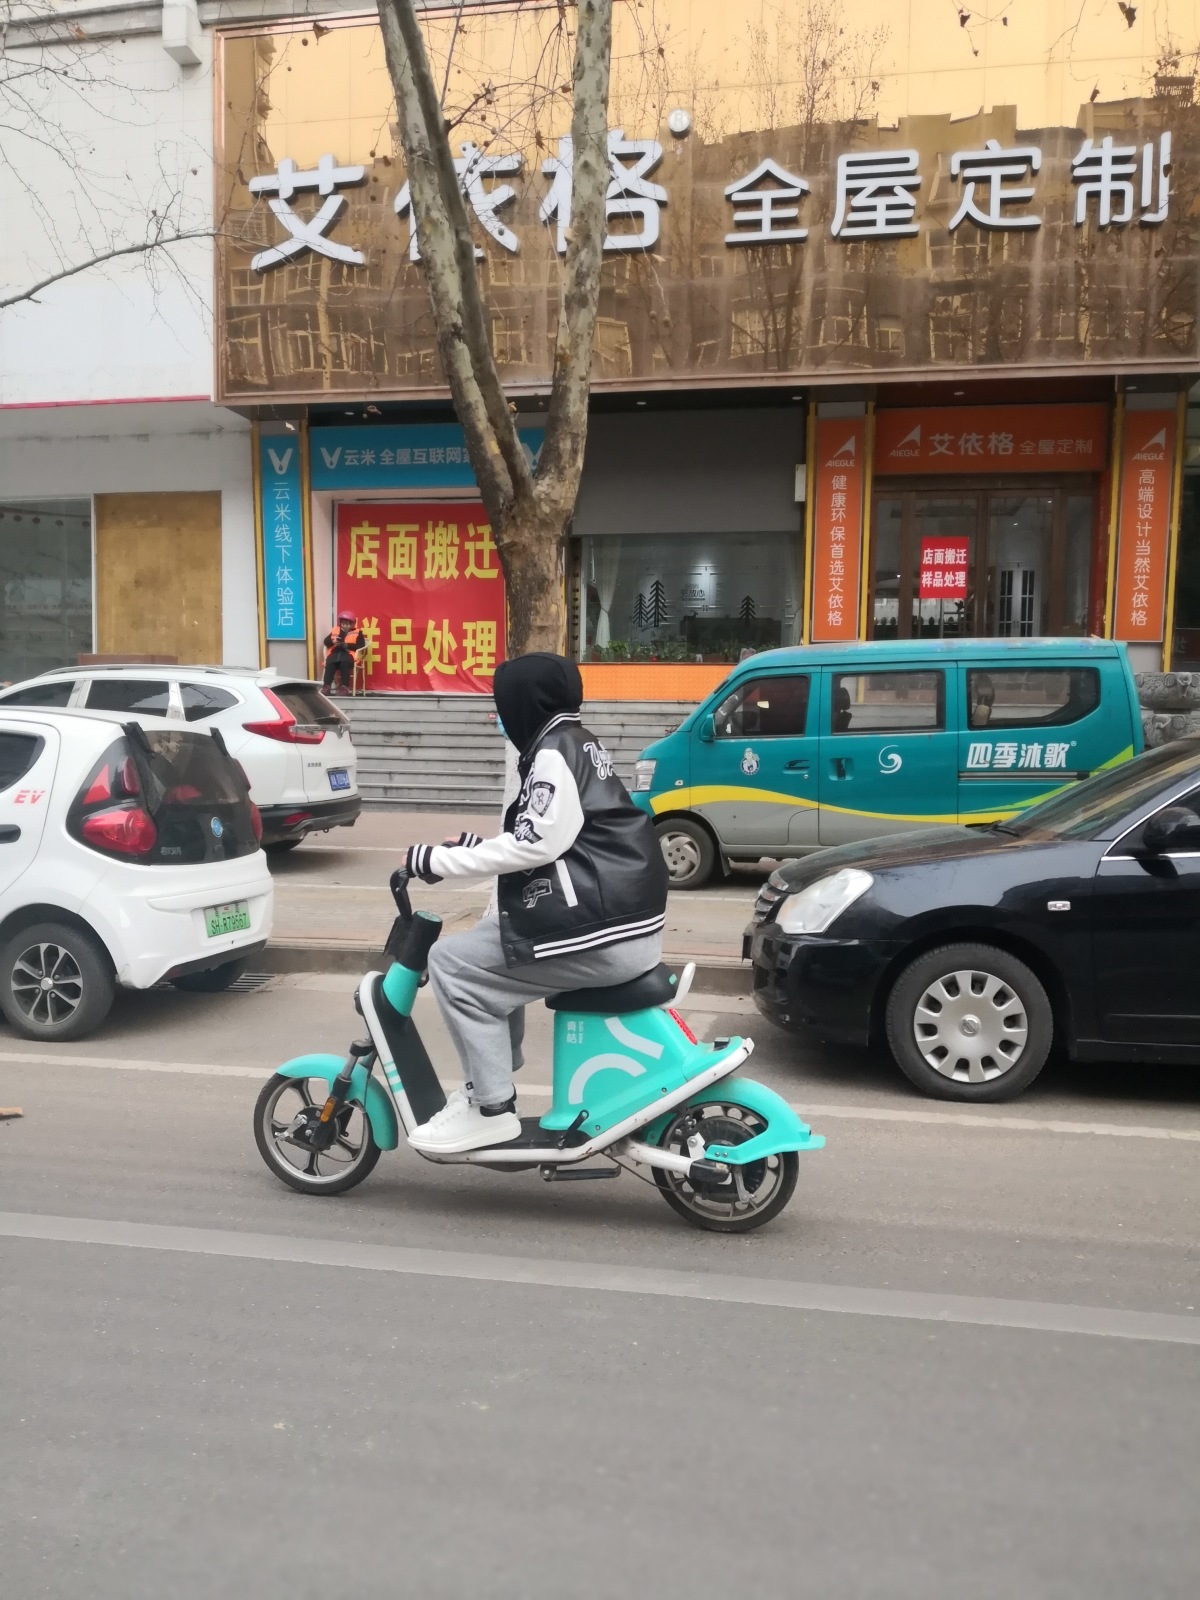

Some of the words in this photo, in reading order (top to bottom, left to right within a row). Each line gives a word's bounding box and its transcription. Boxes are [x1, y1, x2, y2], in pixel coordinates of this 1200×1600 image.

[724, 130, 1172, 243] 全屋定制
[928, 431, 1015, 456] 艾依格
[1019, 438, 1093, 456] 全屋定制
[344, 448, 376, 466] 云米
[825, 459, 856, 468] AIEGLE
[1132, 452, 1165, 461] AIEGLE
[273, 481, 294, 627] 云米线下体验店
[347, 520, 499, 580] 店面搬迁
[827, 474, 848, 627] 健康环保首选艾依格
[922, 548, 967, 565] 店面搬迁
[1130, 468, 1155, 626] 高端设计当然艾依格
[921, 570, 966, 588] 样品处理
[13, 790, 46, 804] EV
